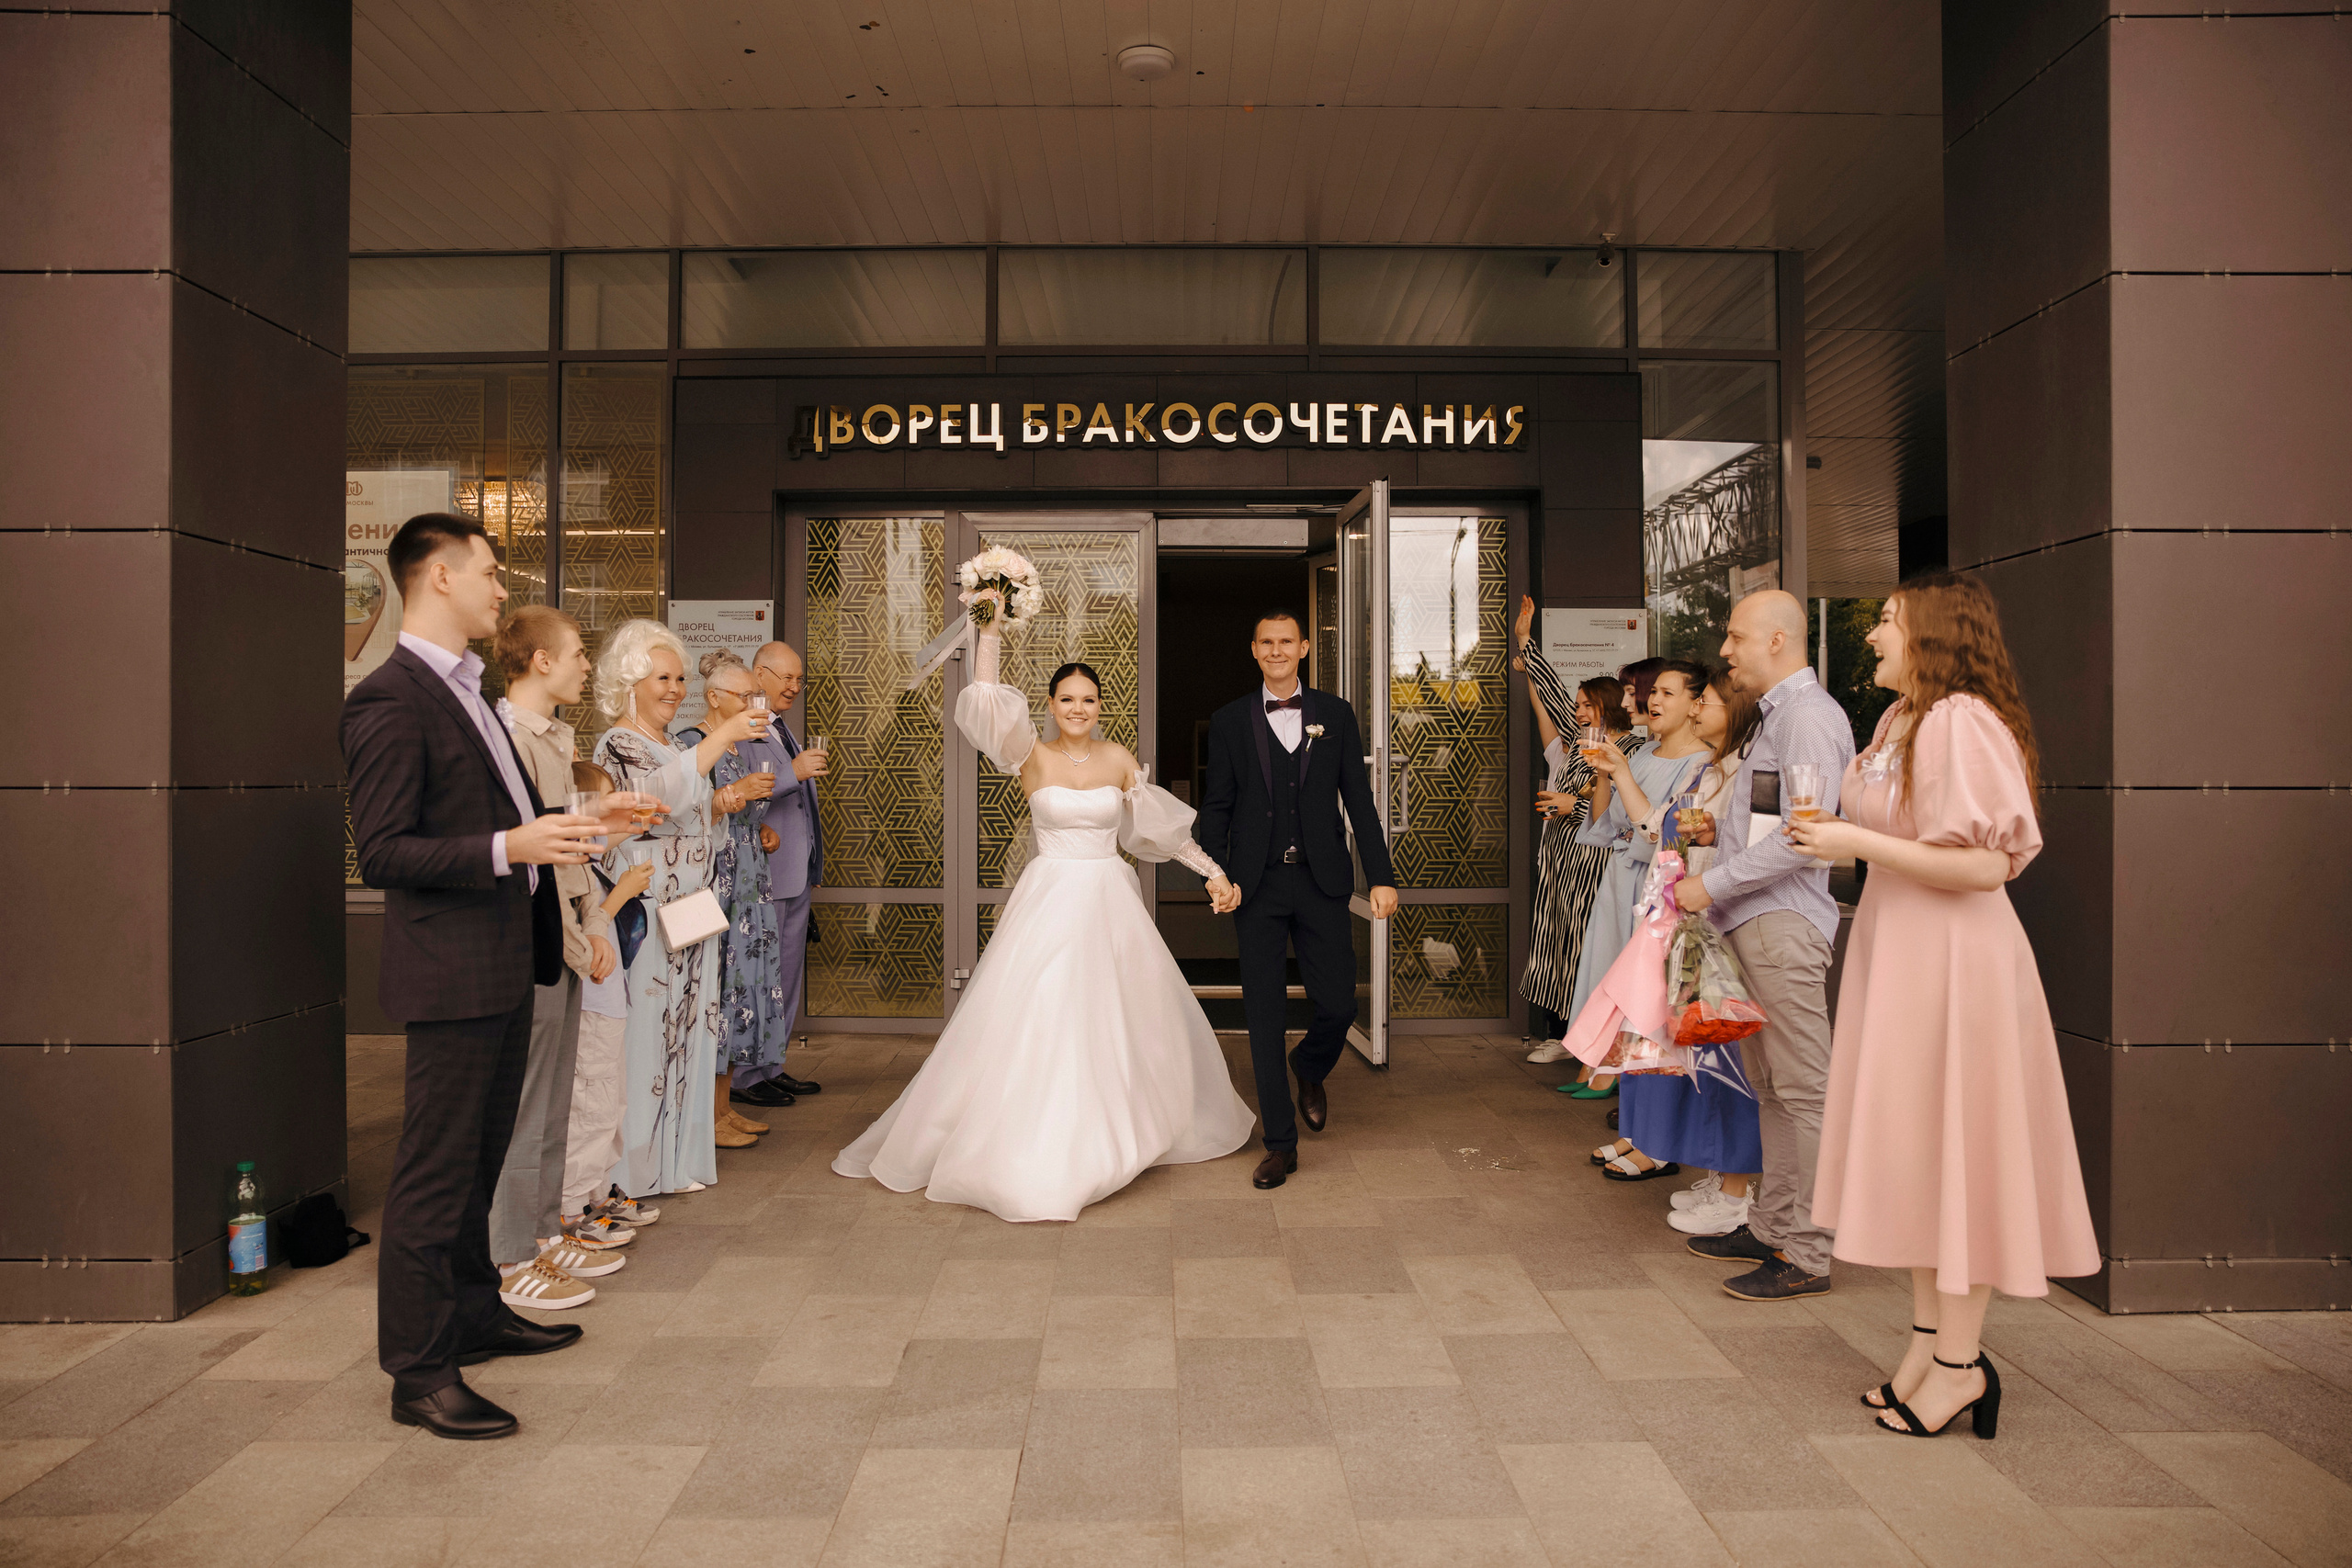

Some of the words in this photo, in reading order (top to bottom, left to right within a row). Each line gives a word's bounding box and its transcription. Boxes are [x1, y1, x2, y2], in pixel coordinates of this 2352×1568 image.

[788, 403, 1004, 453] ДВОРЕЦ
[1023, 402, 1529, 445] БРАКОСОЧЕТАНИЯ
[348, 524, 399, 540] ени
[678, 623, 715, 632] ДВОРЕЦ
